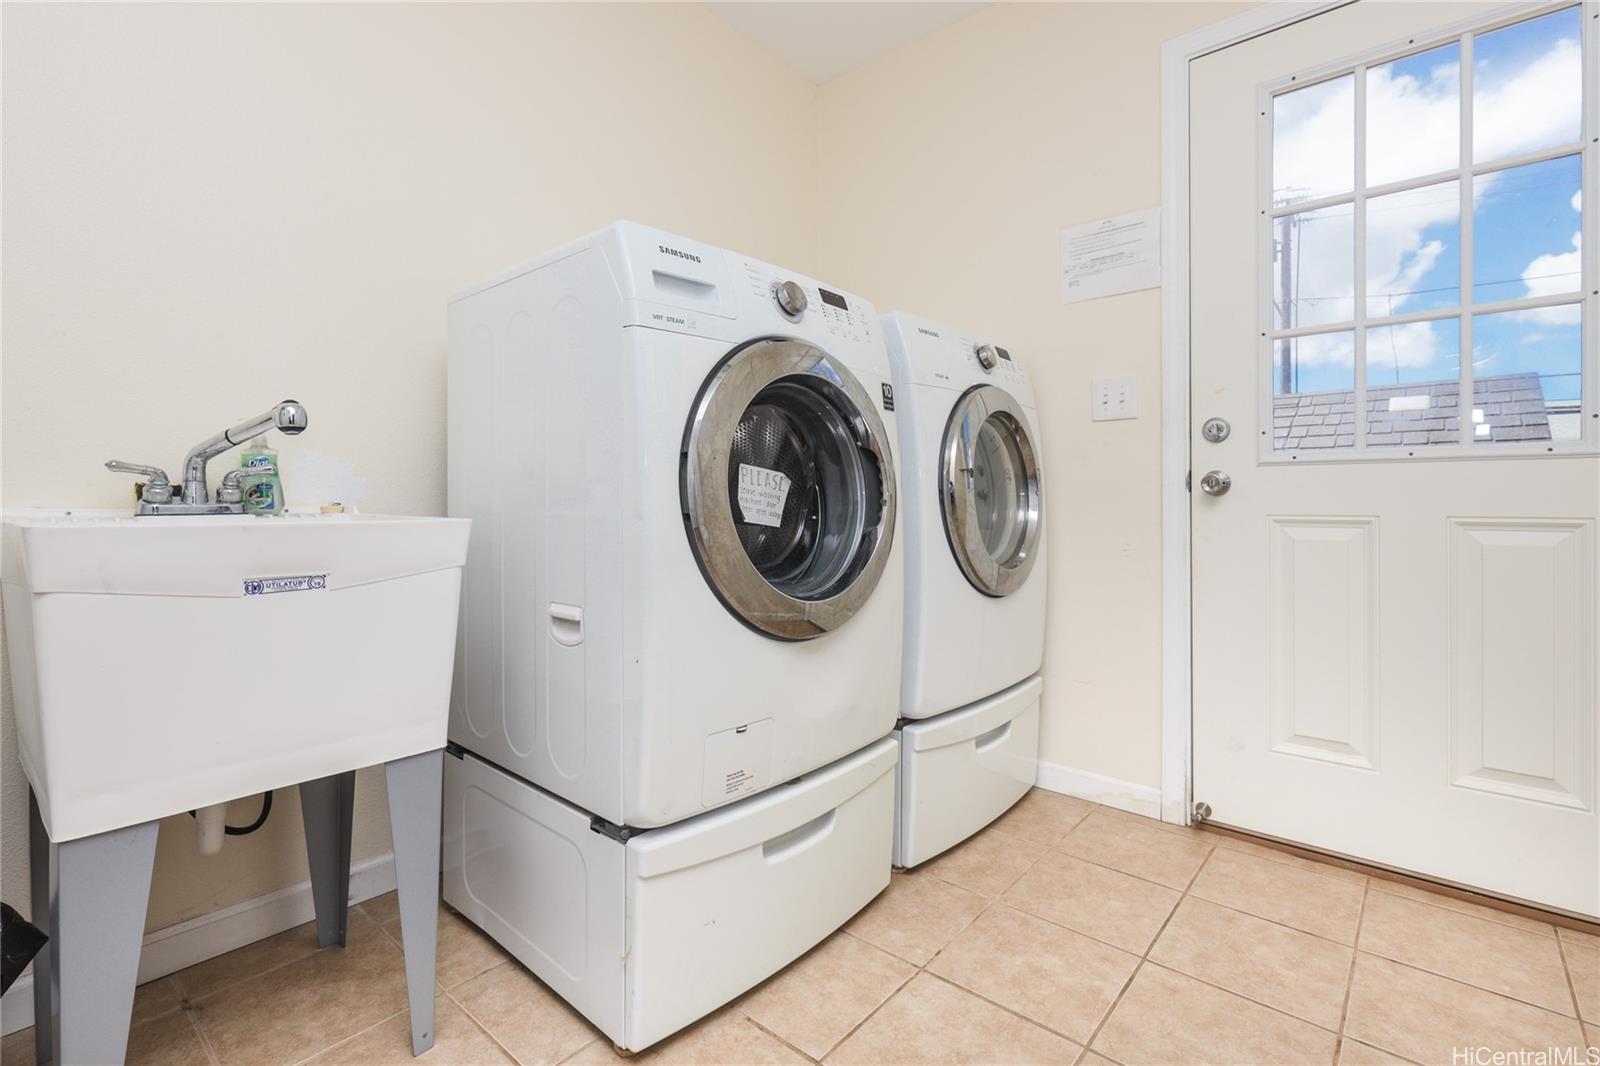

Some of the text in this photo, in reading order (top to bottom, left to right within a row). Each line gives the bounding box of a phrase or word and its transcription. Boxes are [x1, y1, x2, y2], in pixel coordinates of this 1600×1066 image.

[658, 245, 702, 264] SAMSUNG
[666, 315, 685, 325] STEAM
[917, 327, 940, 338] SAMSUNG
[740, 466, 785, 492] PLEASE
